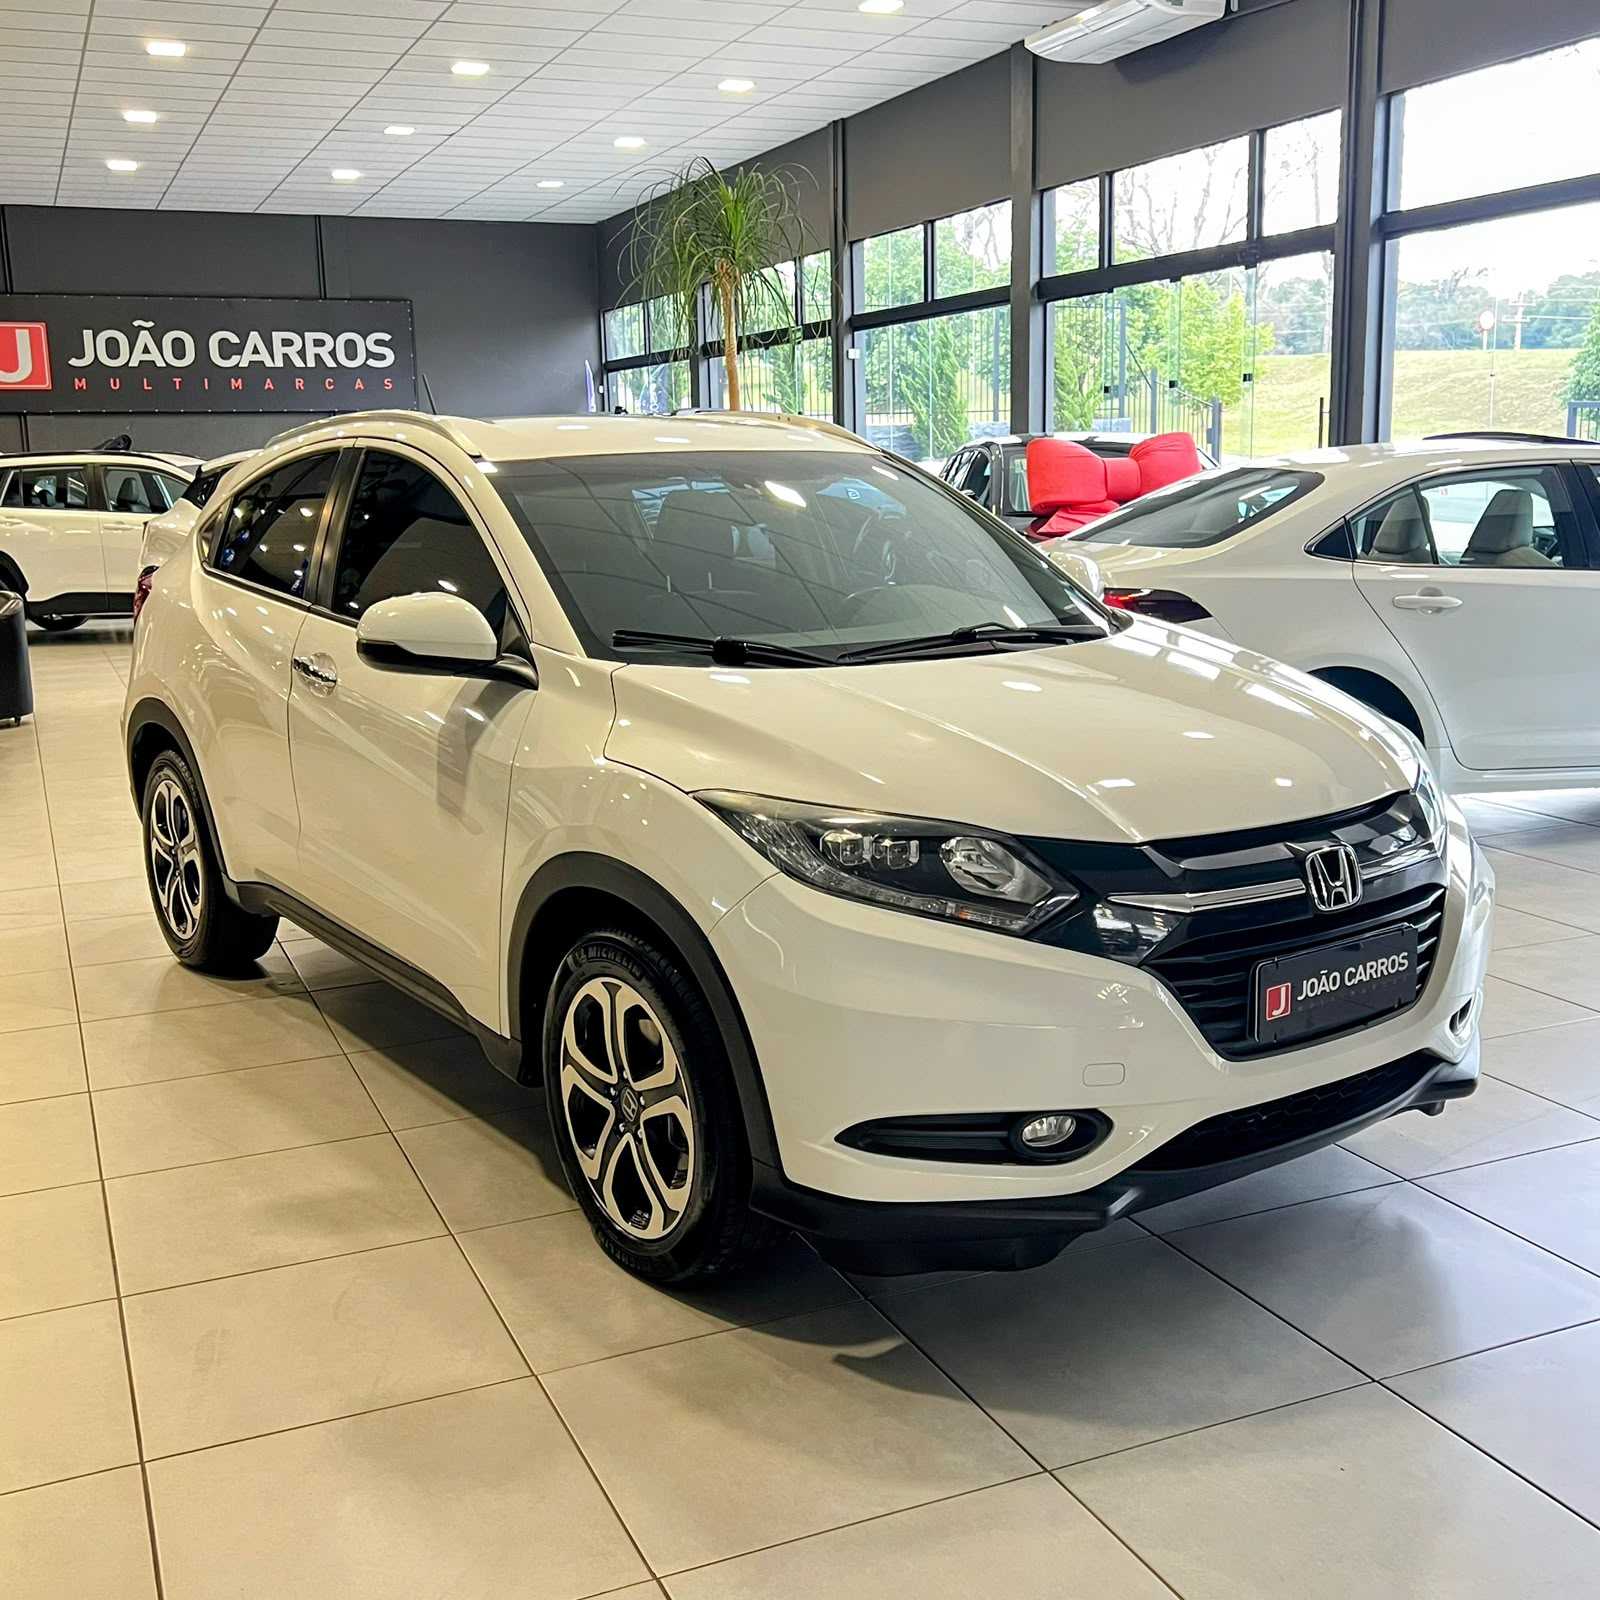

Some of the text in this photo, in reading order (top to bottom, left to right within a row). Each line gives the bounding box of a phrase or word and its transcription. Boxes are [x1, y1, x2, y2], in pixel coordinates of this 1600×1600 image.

[0, 328, 33, 384] J
[67, 319, 395, 369] JOÃO CARROS
[74, 377, 393, 391] MULTIMARCAS
[1297, 970, 1341, 1001] JOÃO
[1344, 952, 1409, 987] CARROS
